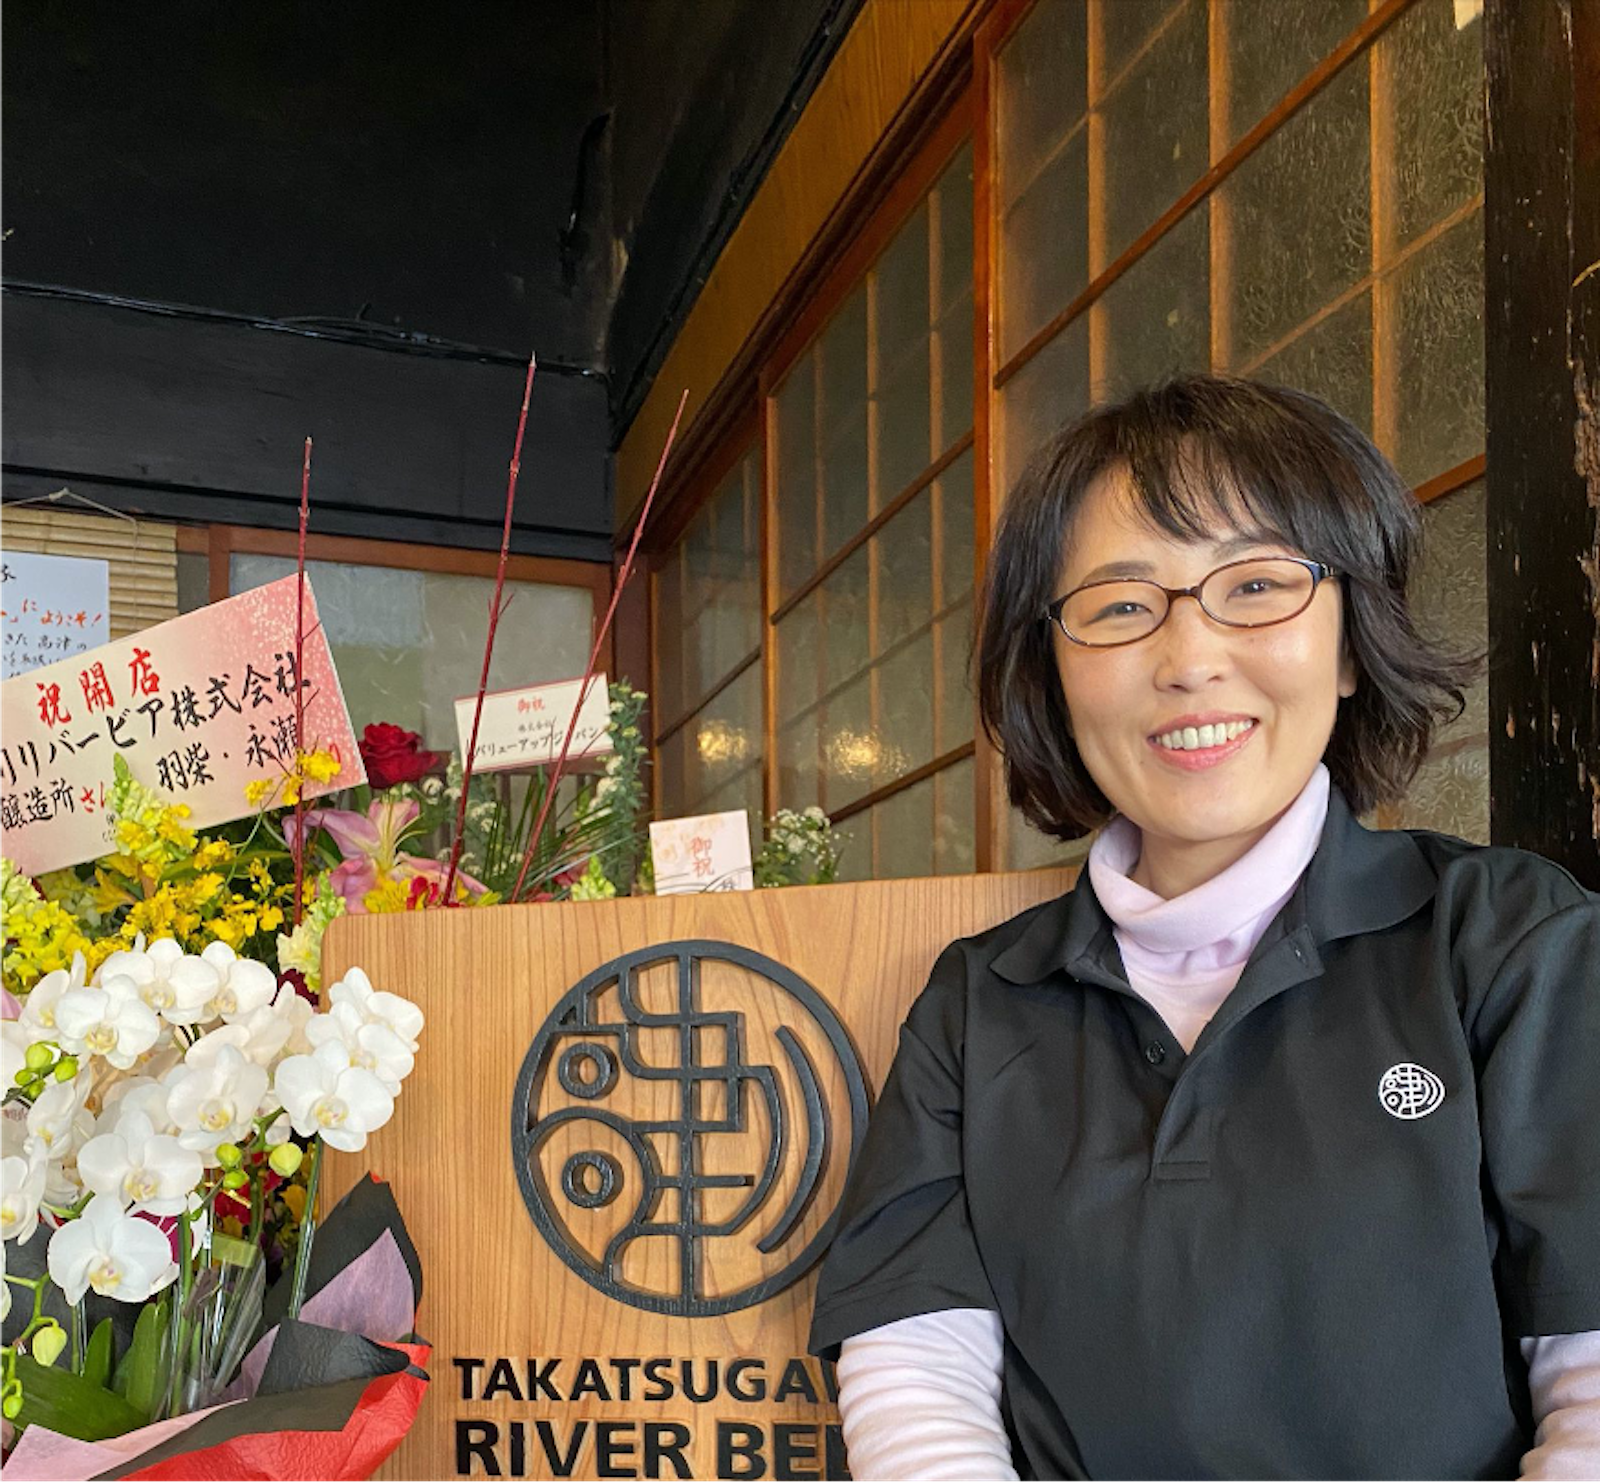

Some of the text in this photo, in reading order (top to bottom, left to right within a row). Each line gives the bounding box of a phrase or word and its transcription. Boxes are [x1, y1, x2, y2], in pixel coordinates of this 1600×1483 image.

[36, 647, 161, 728] 祝開店
[690, 836, 715, 878] 御祝
[455, 1420, 694, 1480] RIVER
